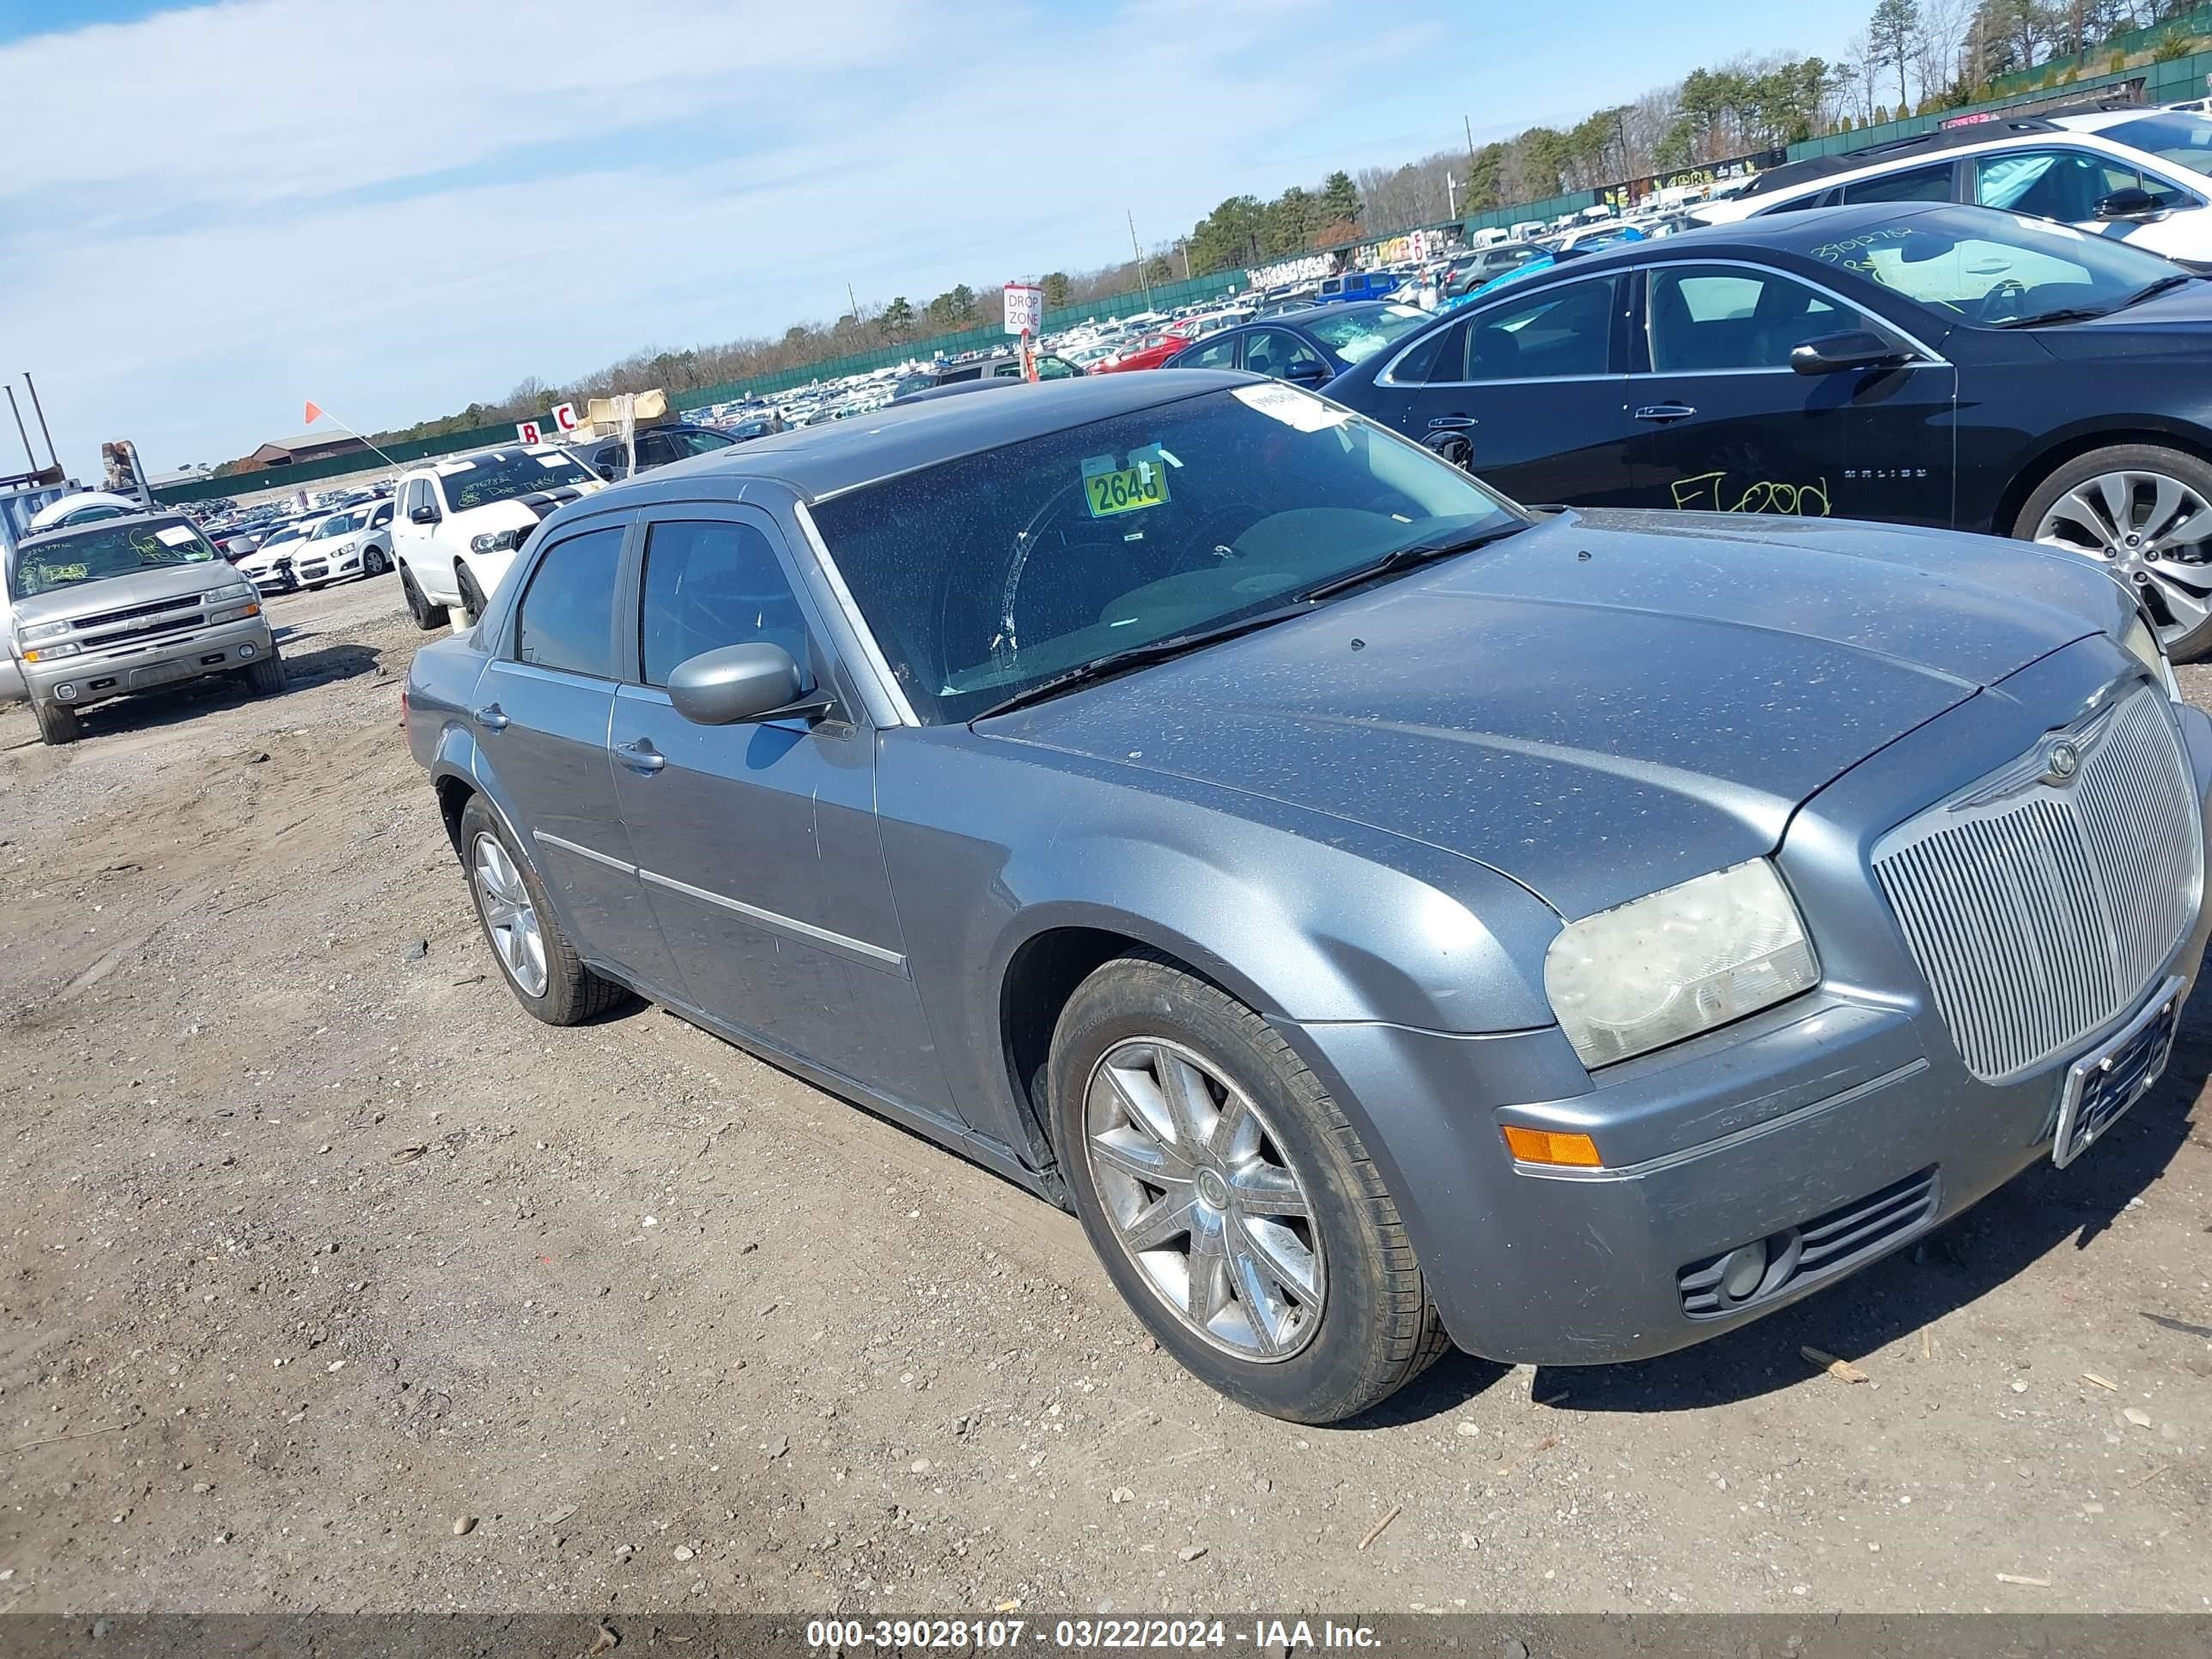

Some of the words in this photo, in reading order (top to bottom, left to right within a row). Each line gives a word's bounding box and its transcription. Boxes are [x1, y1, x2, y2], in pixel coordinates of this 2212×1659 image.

[1008, 295, 1039, 310] DROP
[1009, 311, 1039, 326] ZONE
[558, 407, 574, 429] C
[523, 424, 539, 445] B
[1844, 469, 1928, 478] MALIBU
